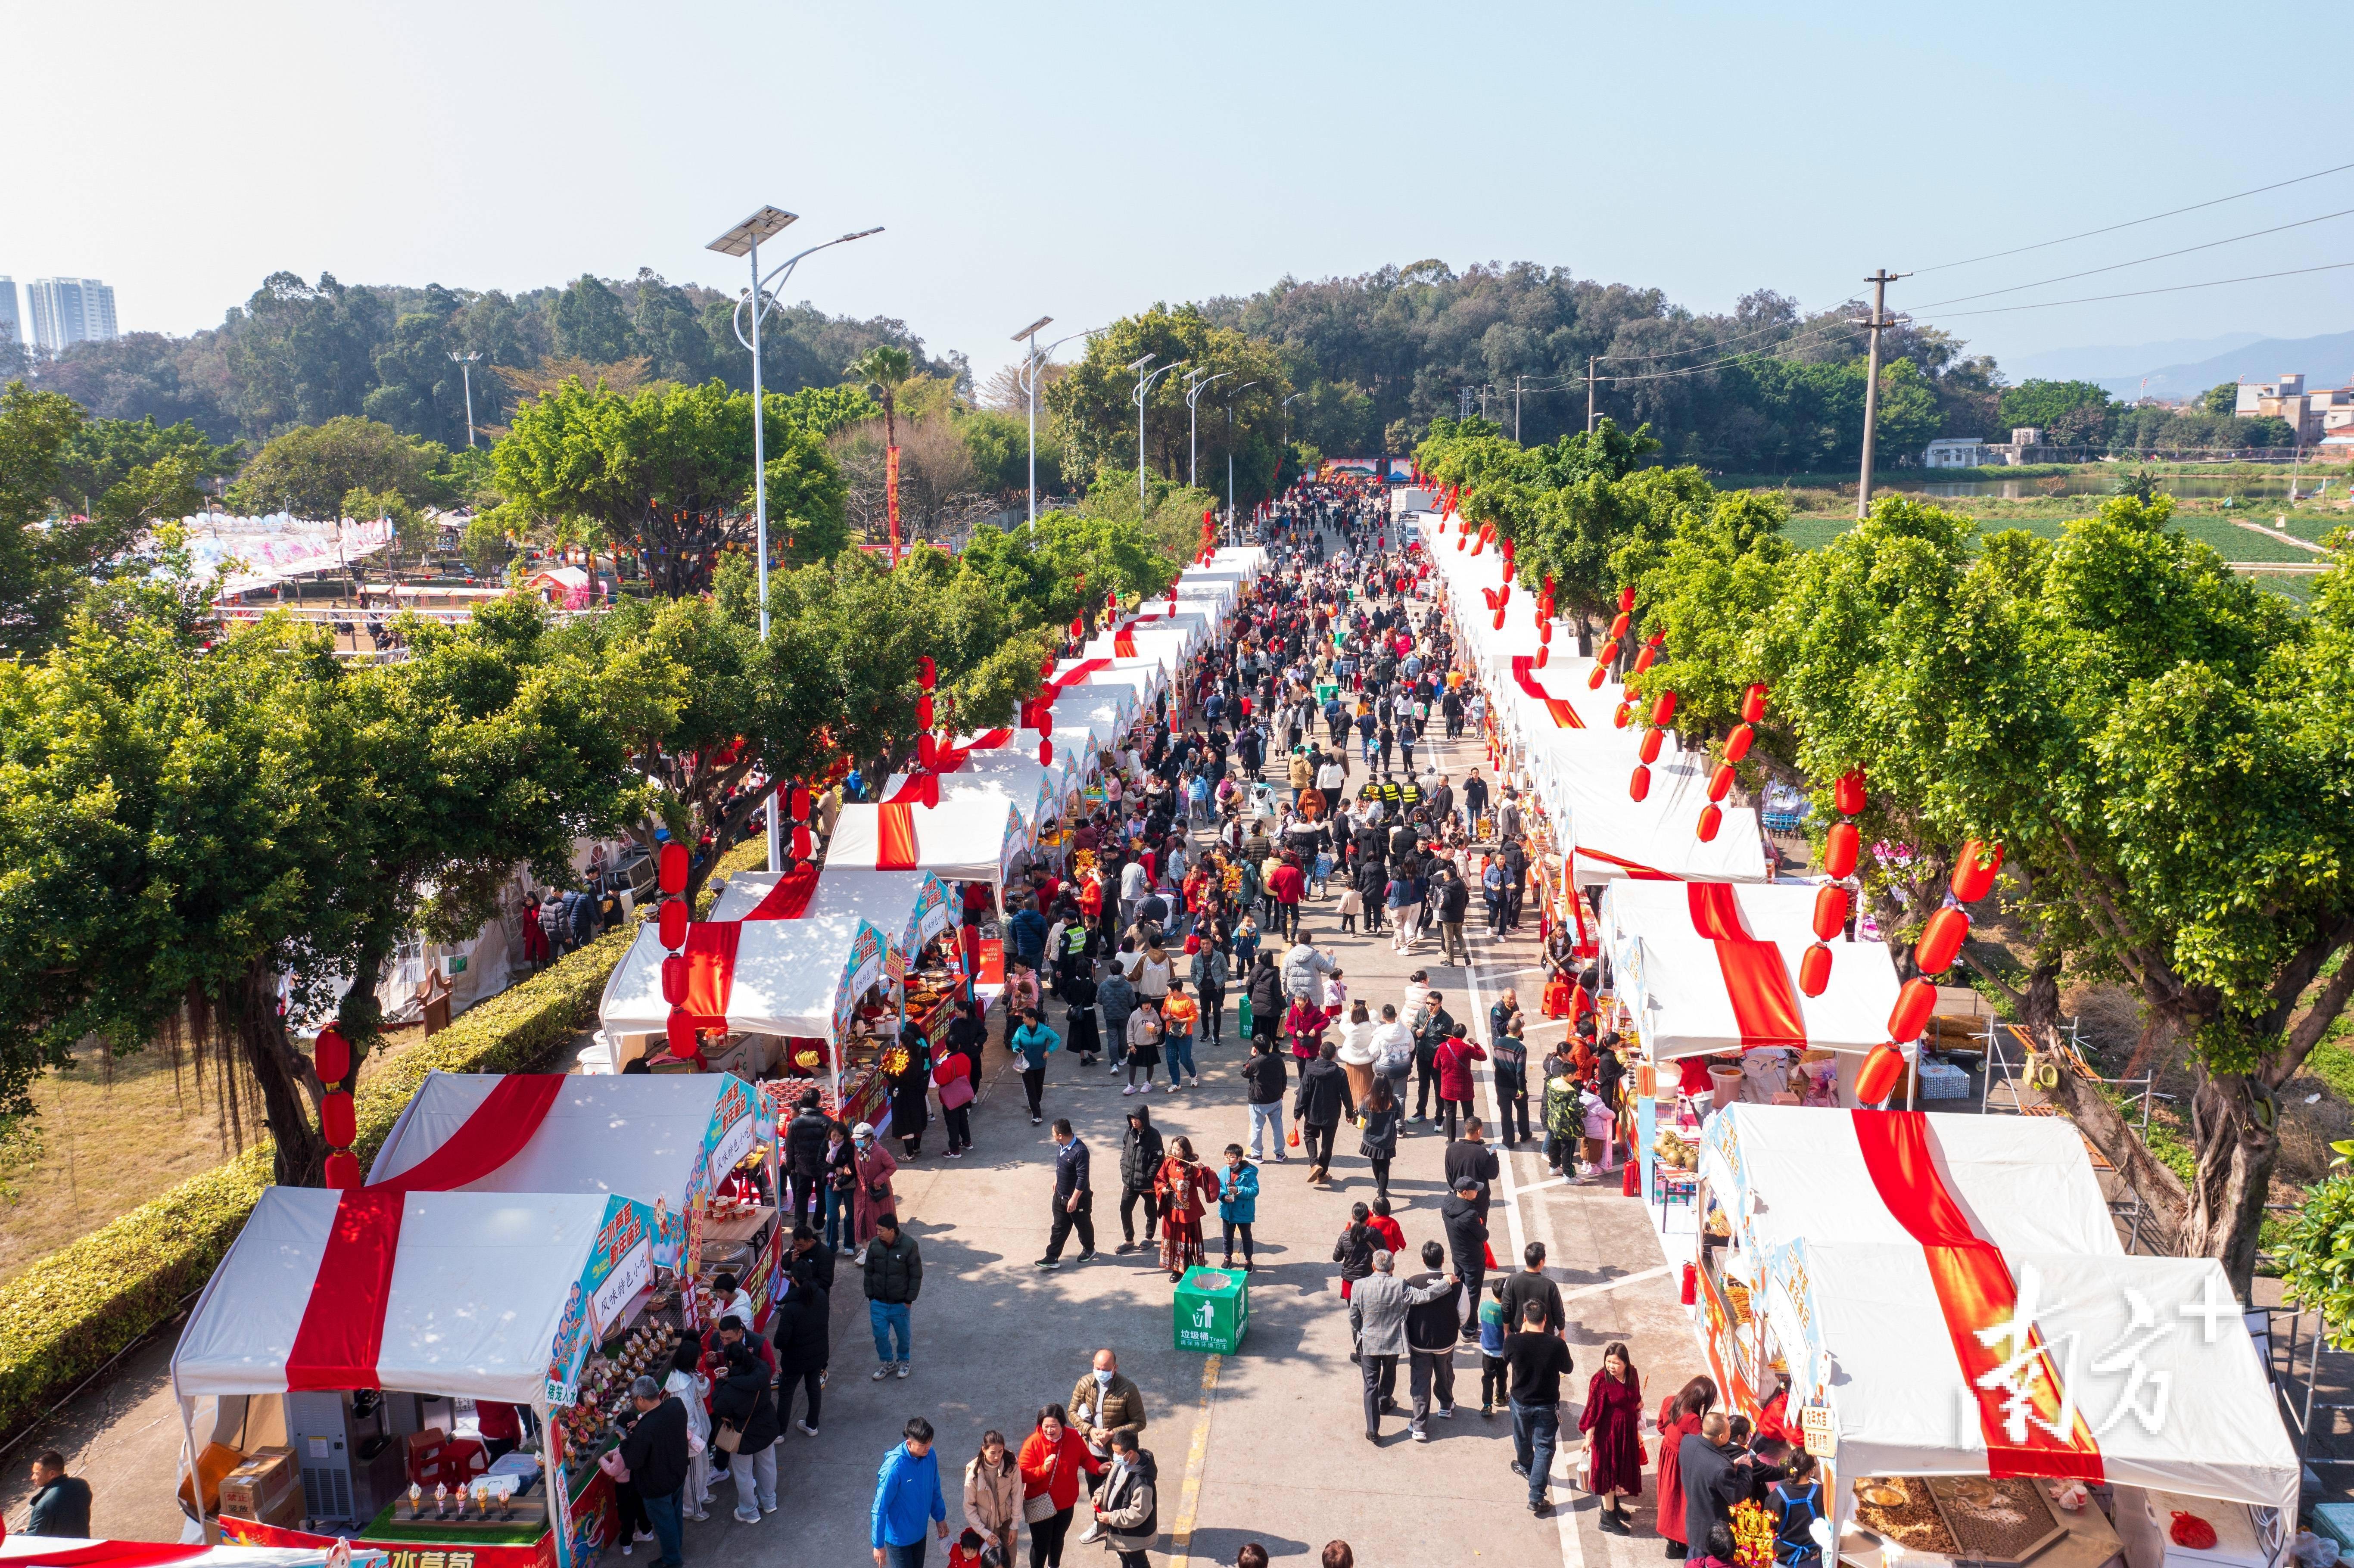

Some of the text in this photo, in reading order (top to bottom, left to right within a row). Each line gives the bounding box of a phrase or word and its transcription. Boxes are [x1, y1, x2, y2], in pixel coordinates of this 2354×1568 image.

[927, 888, 941, 909] 新年庙会
[924, 911, 945, 934] 风味特色小吃
[855, 927, 872, 953] 三水芦苞
[860, 937, 877, 963] 新年庙会
[855, 964, 877, 992] 风味特色小吃
[935, 997, 954, 1026] 三水芦苞
[930, 1018, 949, 1048] 新年庙会
[715, 1080, 738, 1120] 三水芦苞
[722, 1092, 746, 1132] 新年庙会
[864, 1085, 884, 1122] 新年庙会
[717, 1125, 750, 1172] 风味特色小吃
[598, 1201, 632, 1254] 三水芦苞
[610, 1215, 641, 1267] 新年庙会
[602, 1253, 646, 1316] 风味特色小吃
[750, 1244, 772, 1298] 三水芦苞
[1789, 1276, 1809, 1330] 新年庙会
[1181, 1329, 1209, 1341] 垃圾桶
[1181, 1340, 1227, 1350] 请保持环境卫生
[548, 1383, 576, 1404] 猪笼入水
[1807, 1409, 1827, 1426] 龙年大吉
[227, 1493, 248, 1502] 禁止
